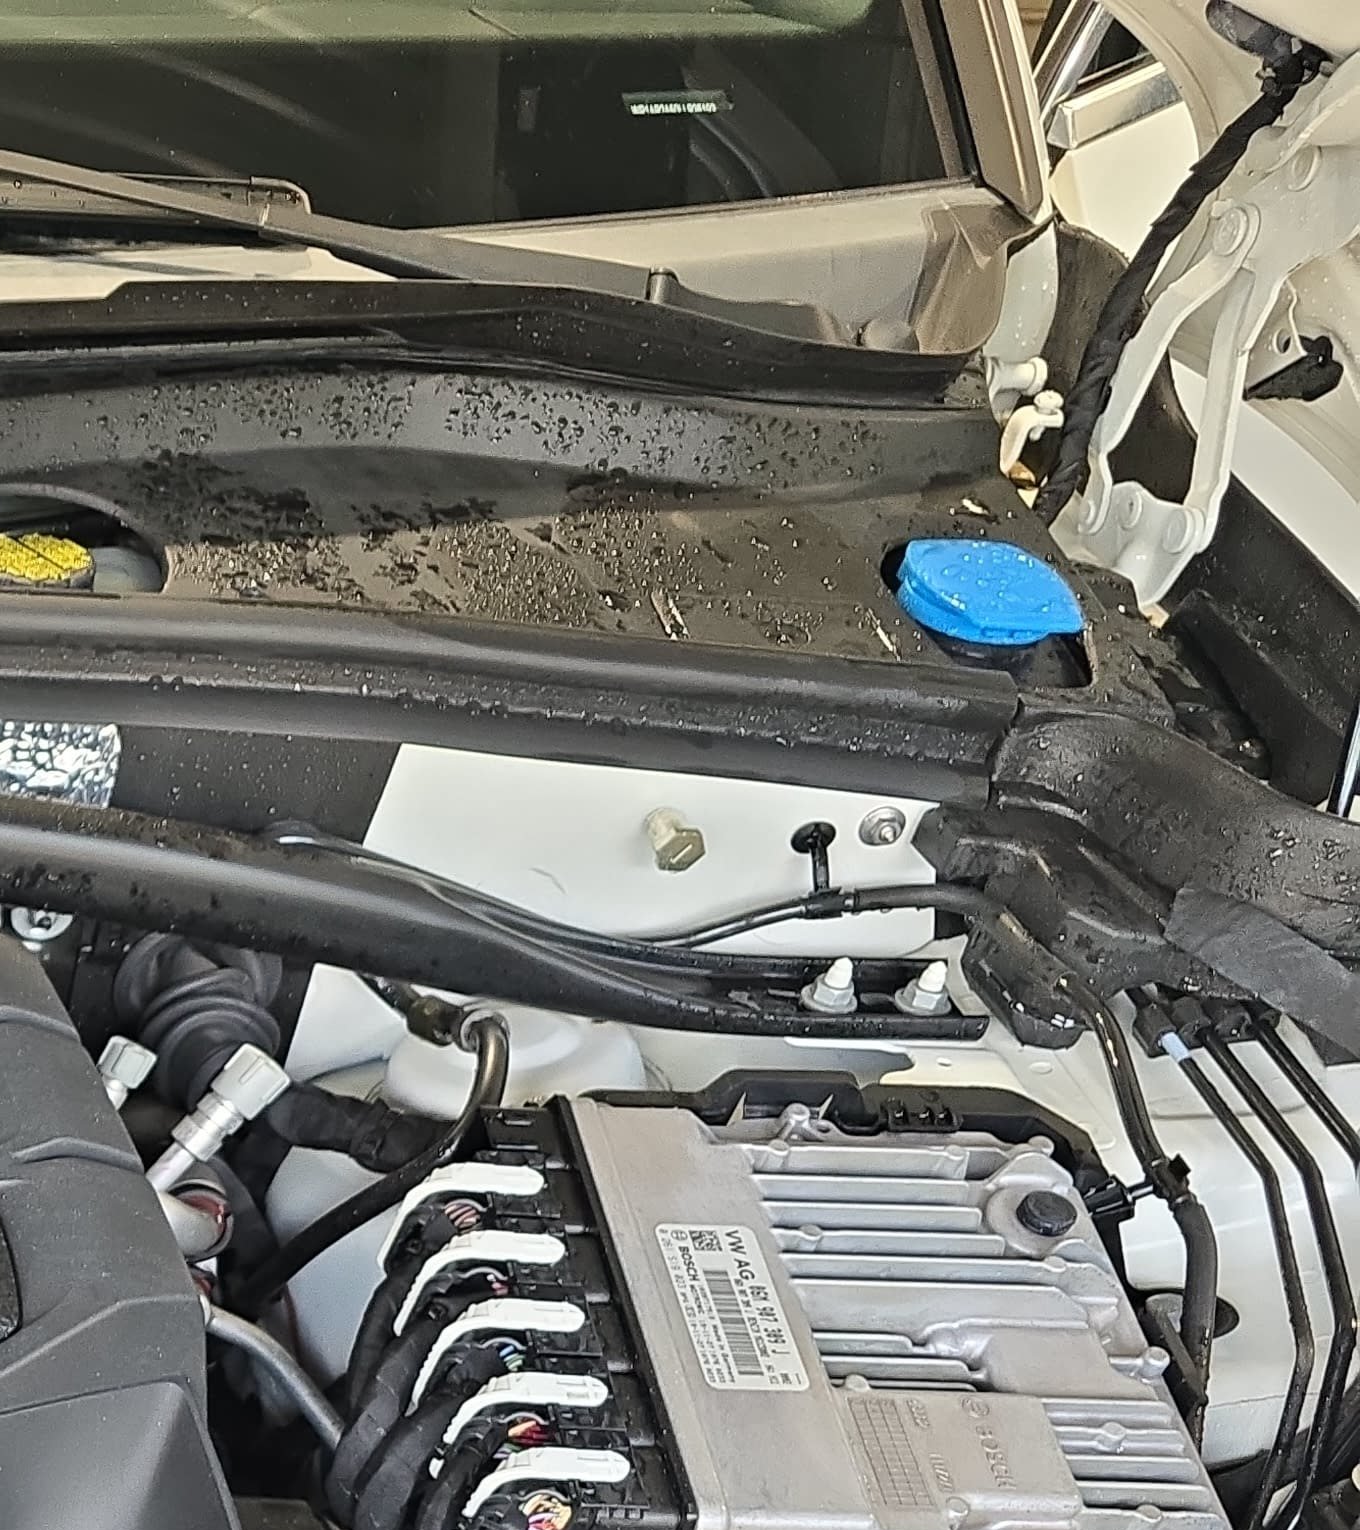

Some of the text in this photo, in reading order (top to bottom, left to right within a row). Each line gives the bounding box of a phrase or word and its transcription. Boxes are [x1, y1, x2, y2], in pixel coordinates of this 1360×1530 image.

[725, 1229, 747, 1256] VW
[678, 1245, 700, 1282] BOSCH
[733, 1257, 756, 1281] AG
